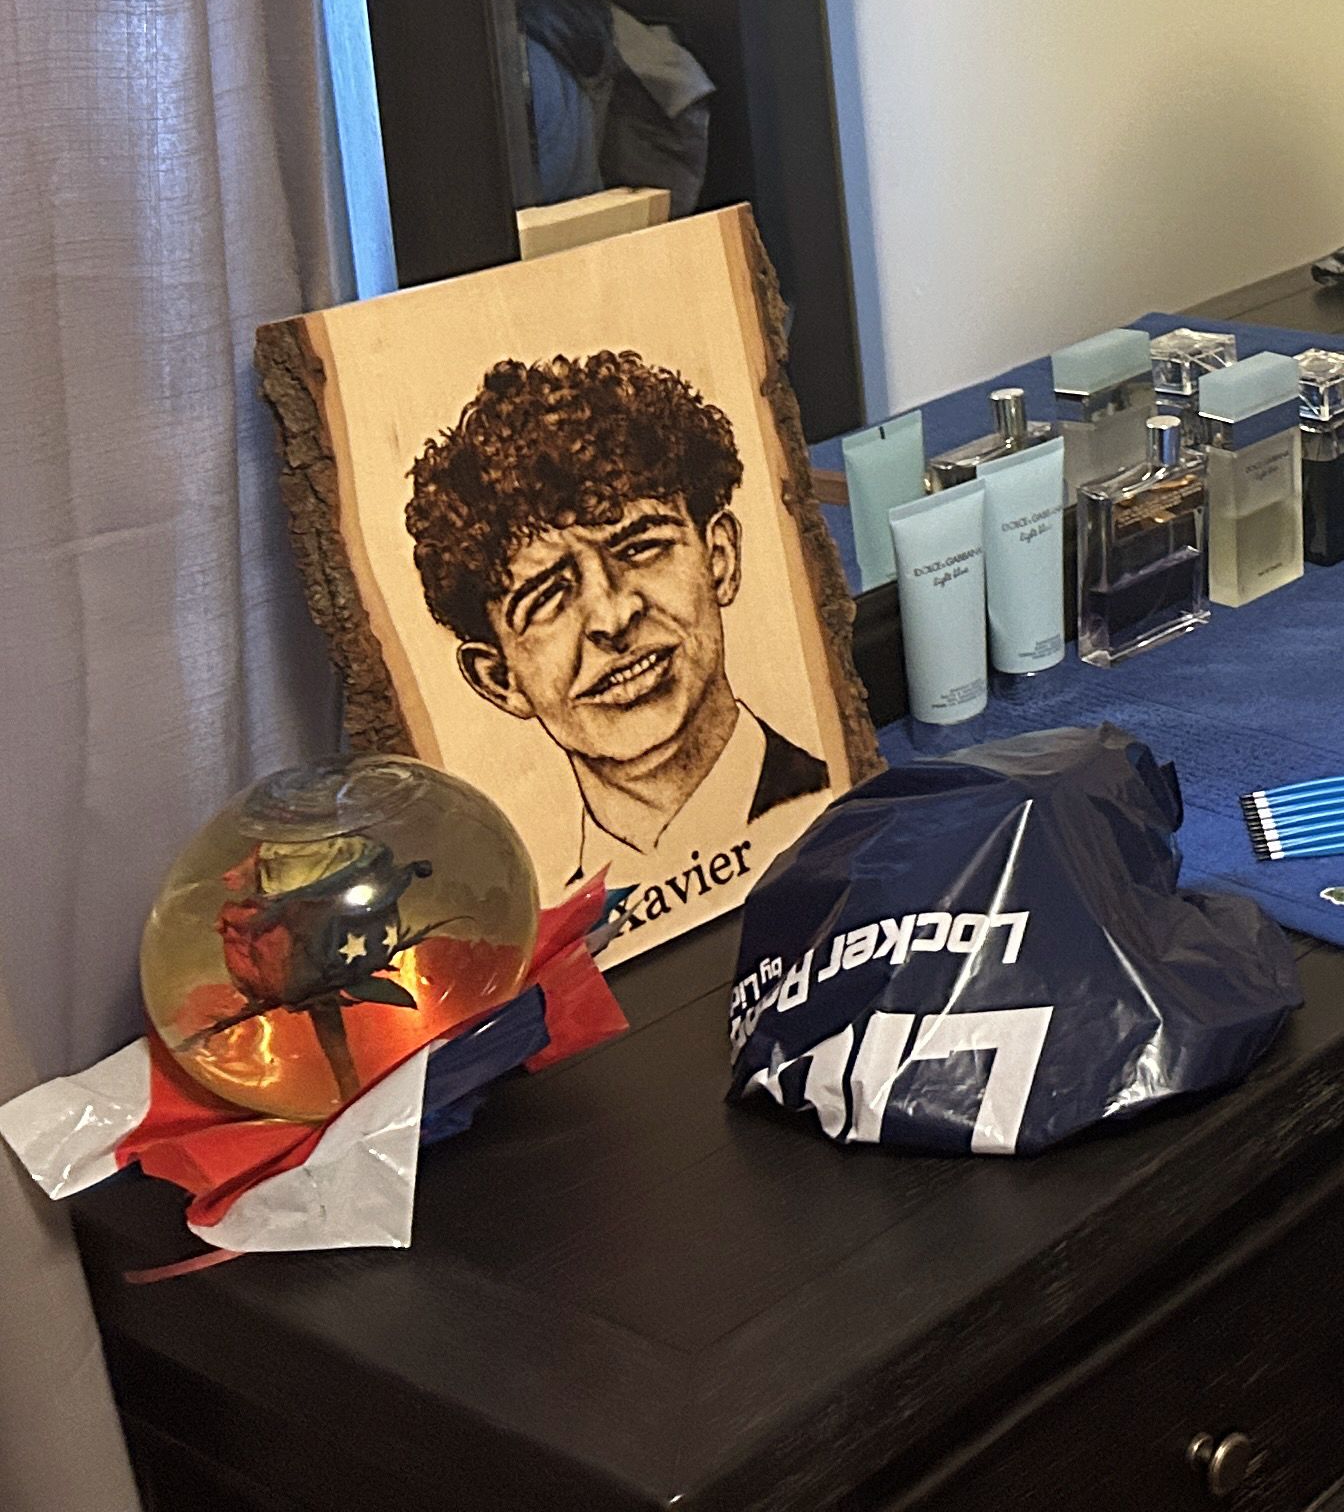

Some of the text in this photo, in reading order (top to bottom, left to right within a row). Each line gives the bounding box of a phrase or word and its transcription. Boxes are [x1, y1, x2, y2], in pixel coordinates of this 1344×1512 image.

[608, 838, 753, 941] Xavier
[758, 954, 783, 982] by
[816, 910, 1031, 985] Locker
